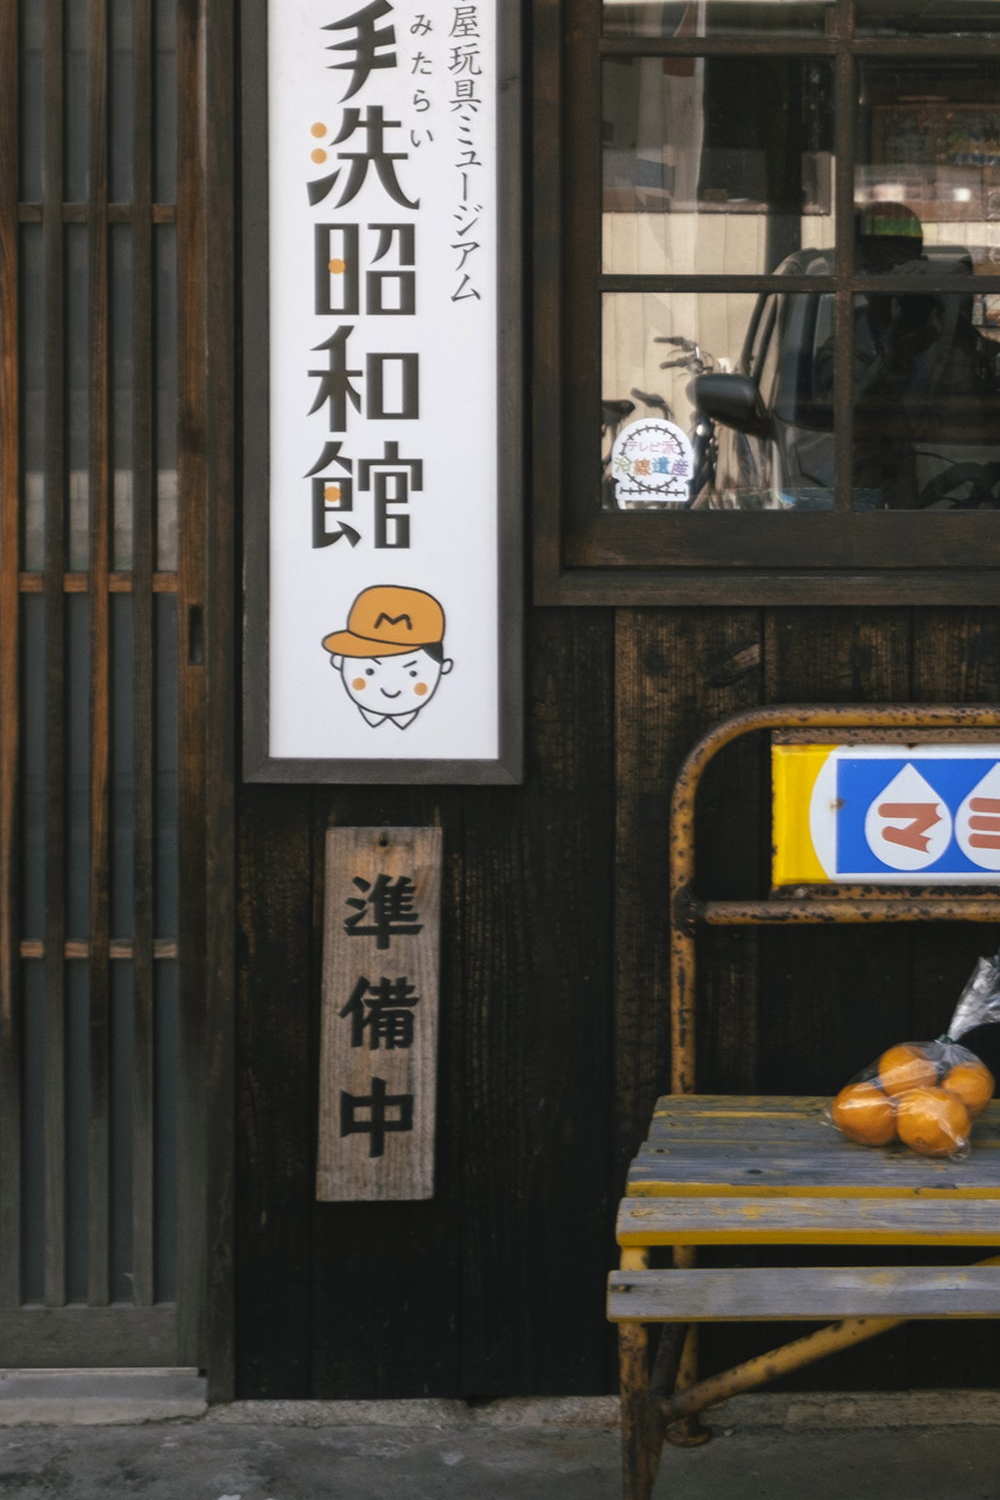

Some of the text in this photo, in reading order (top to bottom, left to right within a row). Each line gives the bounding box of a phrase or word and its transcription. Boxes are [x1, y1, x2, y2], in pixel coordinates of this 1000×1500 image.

[410, 13, 434, 148] みたらい
[614, 455, 689, 478] 沿線遺産
[626, 440, 677, 454] テレビ派
[338, 873, 424, 1158] 準備中
